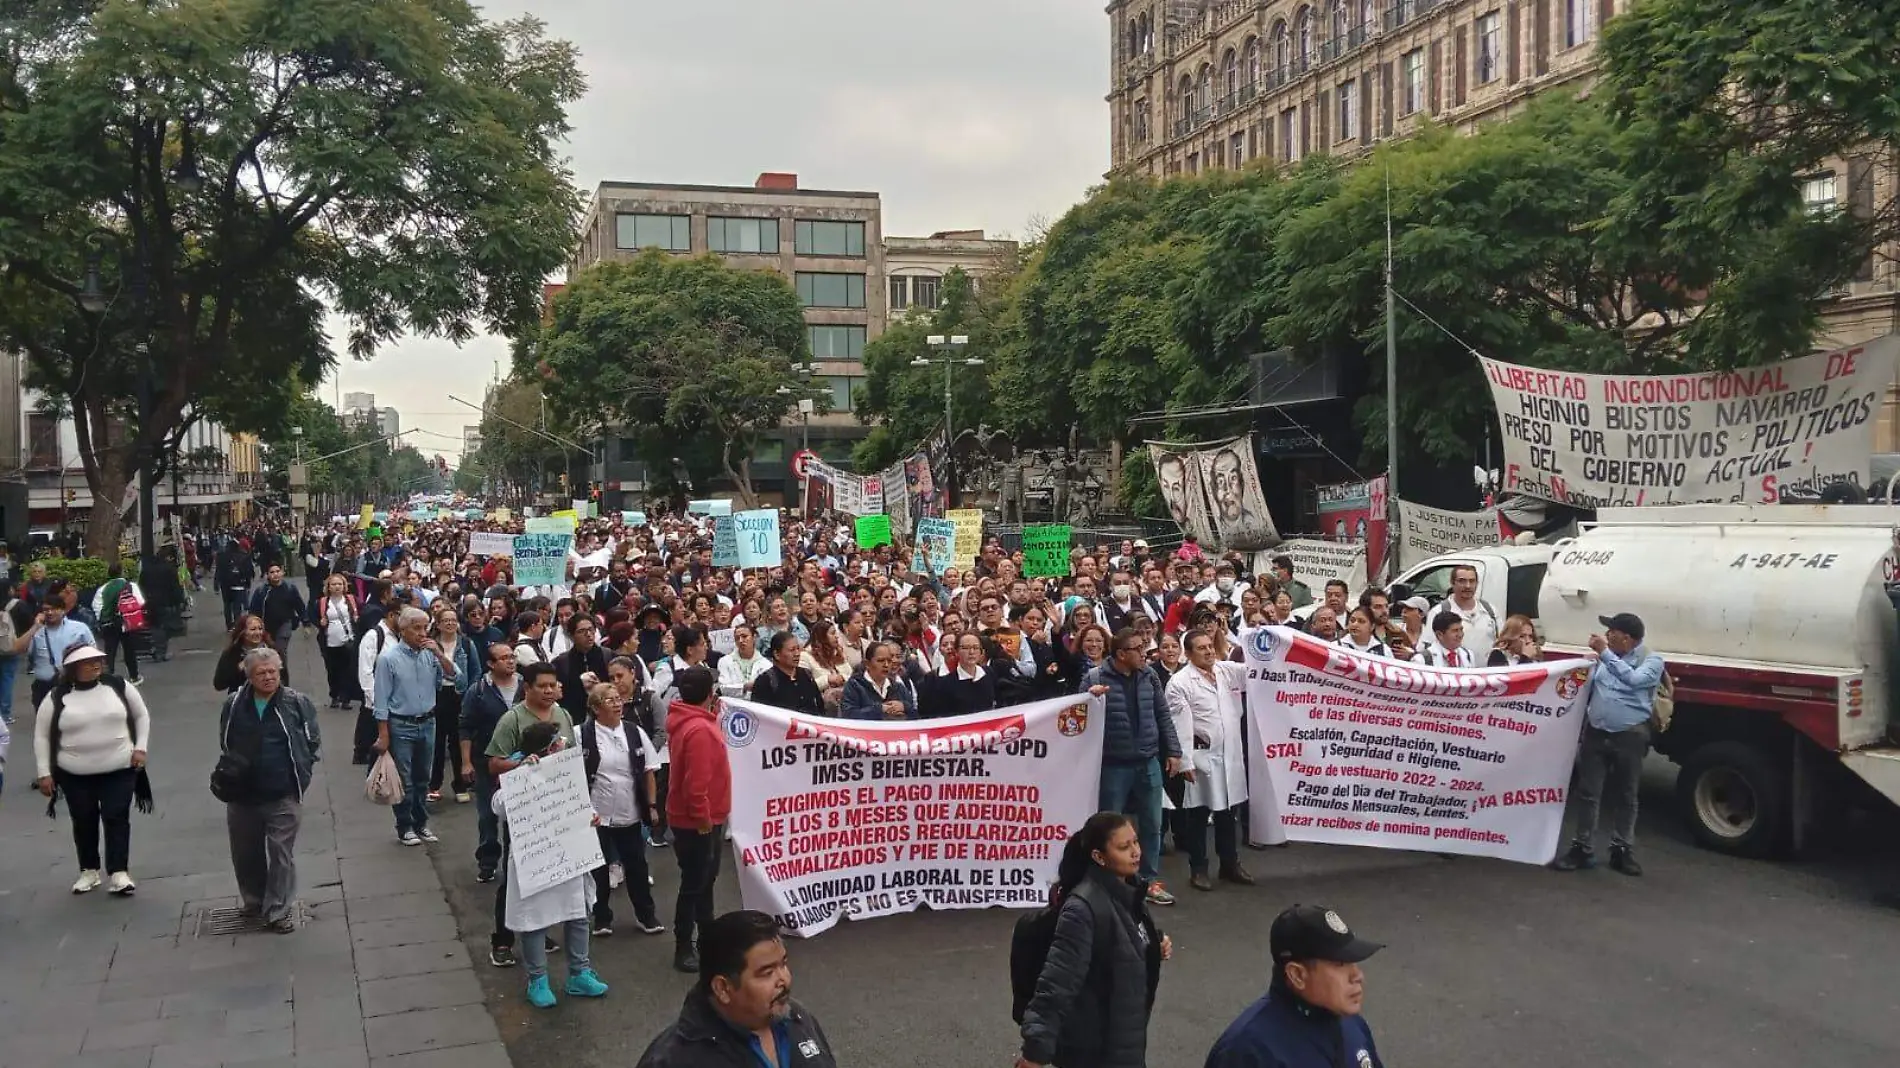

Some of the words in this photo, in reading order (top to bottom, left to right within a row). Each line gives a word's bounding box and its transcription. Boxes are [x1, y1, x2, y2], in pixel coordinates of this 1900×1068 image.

[1604, 367, 1789, 403] INCONDICIONAL
[1824, 348, 1865, 381] DE
[1519, 393, 1590, 427] HIGINIO
[1606, 405, 1691, 431] BUSTOS
[1505, 413, 1551, 446] PRESO
[1570, 428, 1607, 456] POR
[1627, 430, 1729, 459] MOTIVOS
[1507, 464, 1552, 498] Frente
[1530, 445, 1562, 474] DEL
[1583, 457, 1686, 487] GOBIERNO
[1705, 448, 1792, 484] ACTUAL
[751, 532, 768, 555] 10
[1409, 521, 1422, 534] EL
[1431, 527, 1499, 545] COMPAÑERO
[1564, 551, 1614, 565] CH-048
[1730, 552, 1838, 570] A-947-AE
[1289, 670, 1364, 695] Trabajadora
[1367, 691, 1417, 706] respeto
[1327, 649, 1509, 697] EXIGIMOS
[732, 717, 747, 734] 10
[1276, 690, 1317, 706] Urgente
[1466, 712, 1483, 724] de
[1488, 714, 1538, 736] trabajo
[1309, 706, 1323, 720] de
[1327, 707, 1345, 721] las
[1349, 710, 1403, 728] diversas
[1406, 718, 1487, 740] comisiones.
[761, 744, 797, 770] LOS
[1290, 727, 1347, 744] Escalafón,
[1351, 730, 1438, 754] Capacitación,
[1442, 741, 1507, 764] Vestuario
[1321, 745, 1328, 758] y
[1330, 743, 1393, 761] Seguridad
[1396, 752, 1405, 762] e
[1408, 751, 1461, 771] Higiene.
[811, 762, 864, 785] IMSS
[871, 758, 990, 780] BIENESTAR.
[1290, 760, 1322, 777] Pago
[1325, 764, 1338, 777] de
[1341, 764, 1399, 782] vestuario
[1402, 771, 1436, 788] 2022
[766, 788, 850, 817] EXIGIMOS
[856, 786, 878, 805] EL
[884, 784, 932, 804] PAGO
[938, 784, 1040, 804] INMEDIATO
[1296, 780, 1329, 796] Pago
[1332, 784, 1350, 797] del
[1374, 787, 1394, 801] del
[1502, 788, 1564, 806] BASTA!
[761, 818, 784, 840] DE
[790, 812, 823, 834] LOS
[828, 812, 839, 828] 8
[846, 804, 908, 829] MESES
[914, 803, 949, 822] QUE
[954, 803, 1043, 824] ADEUDAN
[1352, 799, 1420, 817] Mensuales,
[1424, 806, 1469, 820] Lentes.
[1317, 815, 1362, 831] recibos
[1365, 819, 1380, 832] de
[1434, 827, 1510, 845] pendientes.
[742, 847, 755, 867] A
[755, 841, 783, 863] LOS
[765, 845, 888, 884] FORMALIZADOS
[893, 845, 904, 861] Y
[909, 844, 938, 860] PIE
[944, 843, 968, 860] DE
[974, 843, 1049, 861] RAMA!!!
[784, 889, 800, 908] LA
[798, 874, 876, 904] DIGNIDAD
[881, 868, 964, 889] LABORAL
[969, 869, 998, 886] DE
[1000, 868, 1034, 886] LOS
[866, 892, 893, 912] NO
[895, 889, 918, 906] ES
[922, 888, 1049, 904] TRANSFERIBL
